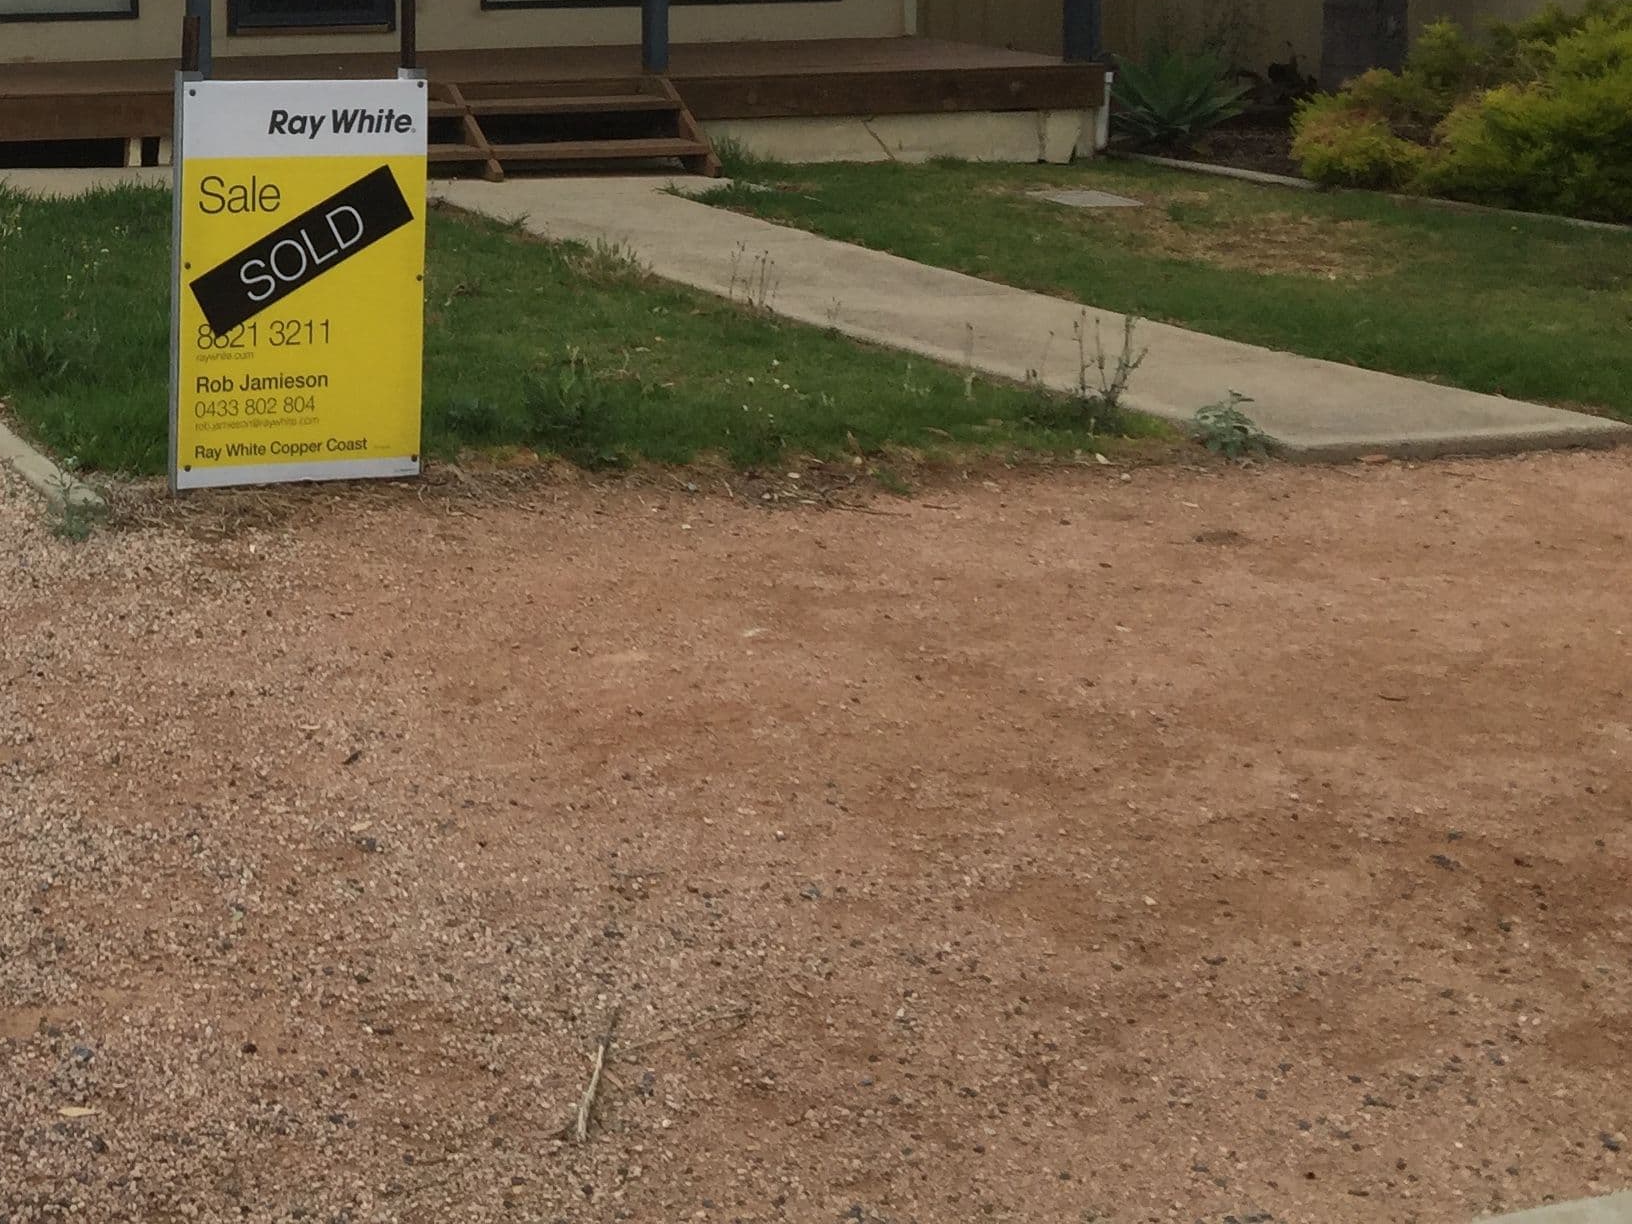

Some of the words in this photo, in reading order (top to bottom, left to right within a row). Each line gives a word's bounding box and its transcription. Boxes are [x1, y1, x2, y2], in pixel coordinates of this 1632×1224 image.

[268, 109, 325, 139] Ray
[332, 109, 412, 134] White
[199, 175, 281, 214] Sale
[240, 205, 364, 301] SOLD
[269, 319, 329, 347] 3211
[196, 375, 234, 394] Rob
[239, 373, 328, 392] Jamieson
[194, 398, 239, 418] 0433
[244, 397, 277, 416] 802
[283, 395, 315, 413] 804
[194, 445, 222, 461] Ray
[226, 442, 266, 457] White
[270, 440, 322, 457] Copper
[326, 437, 368, 452] Coast
